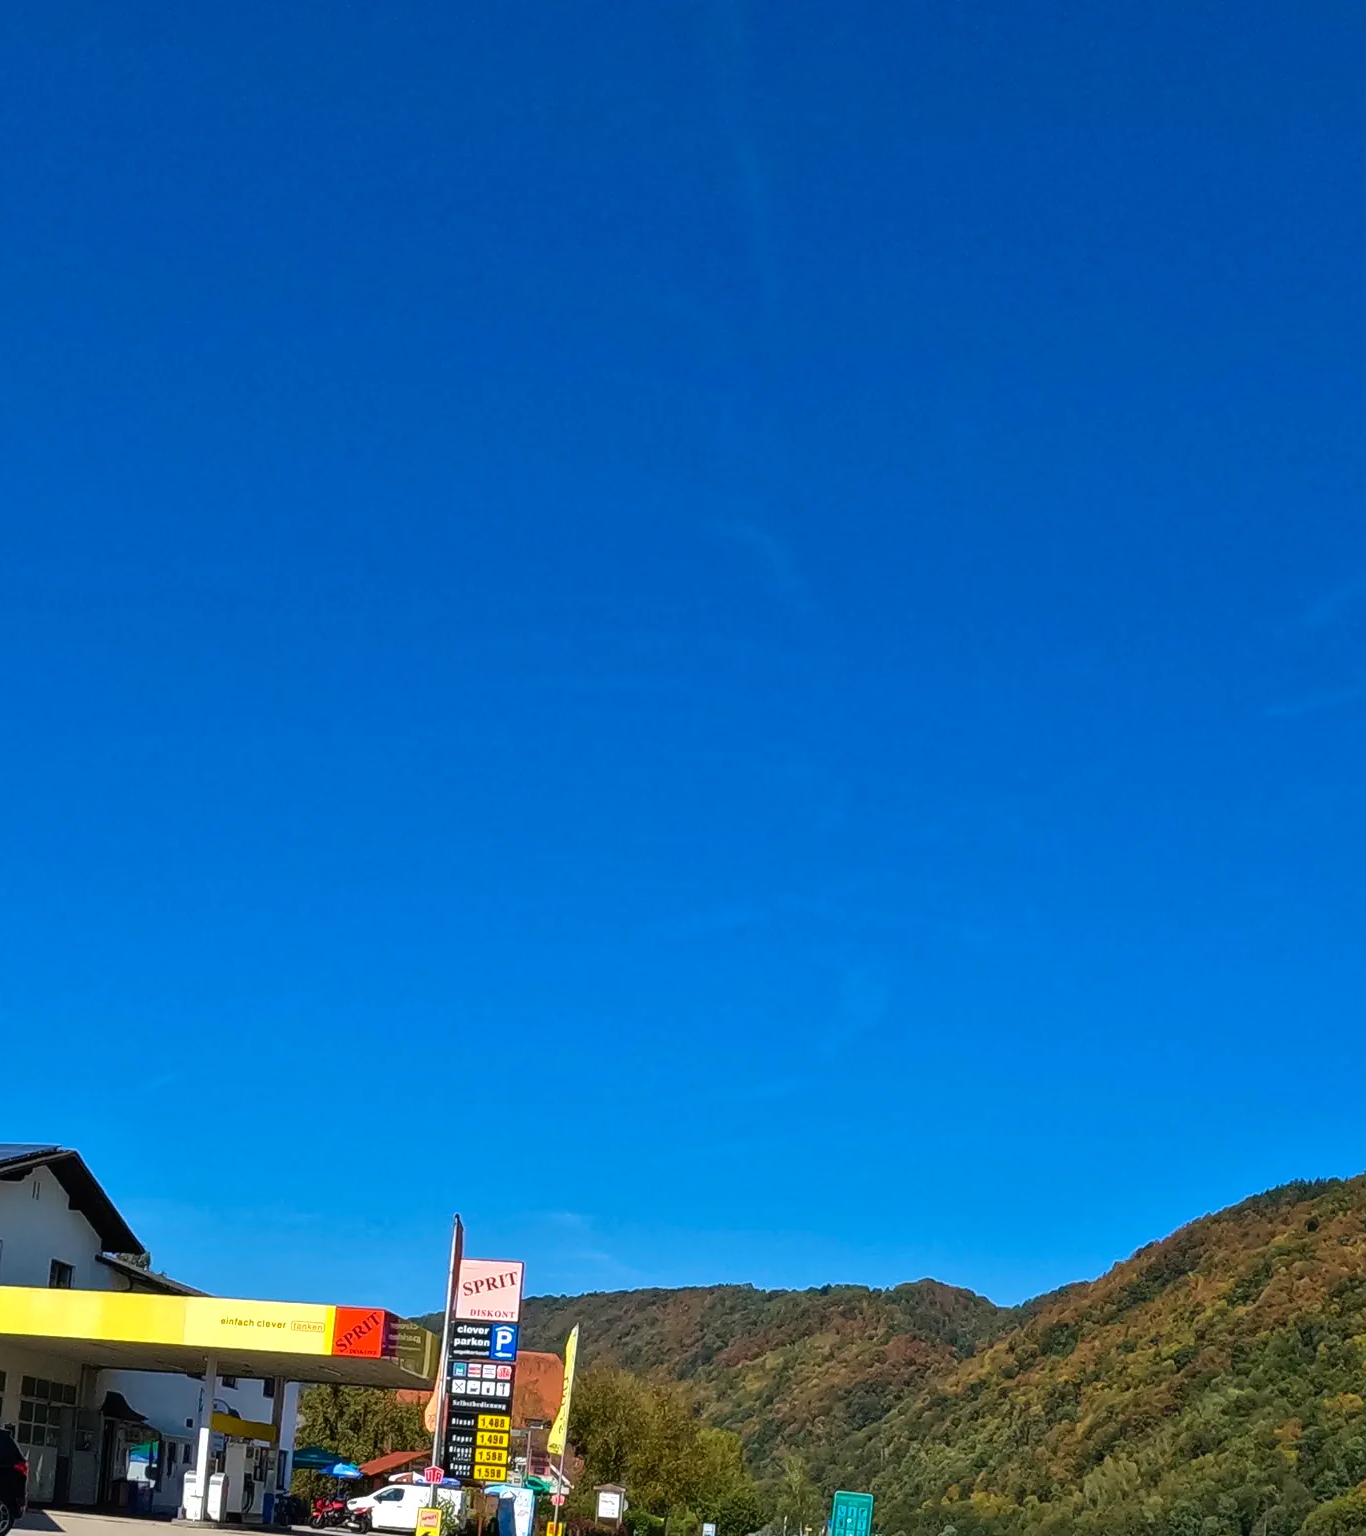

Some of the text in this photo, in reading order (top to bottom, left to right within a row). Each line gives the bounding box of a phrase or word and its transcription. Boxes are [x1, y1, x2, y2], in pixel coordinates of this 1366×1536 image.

[462, 1271, 518, 1297] SPRIT
[469, 1308, 516, 1319] DISKONT
[220, 1316, 255, 1328] einfach
[256, 1319, 287, 1329] clever
[334, 1311, 381, 1353] SPRIT
[457, 1324, 490, 1335] clever
[454, 1337, 491, 1347] parken
